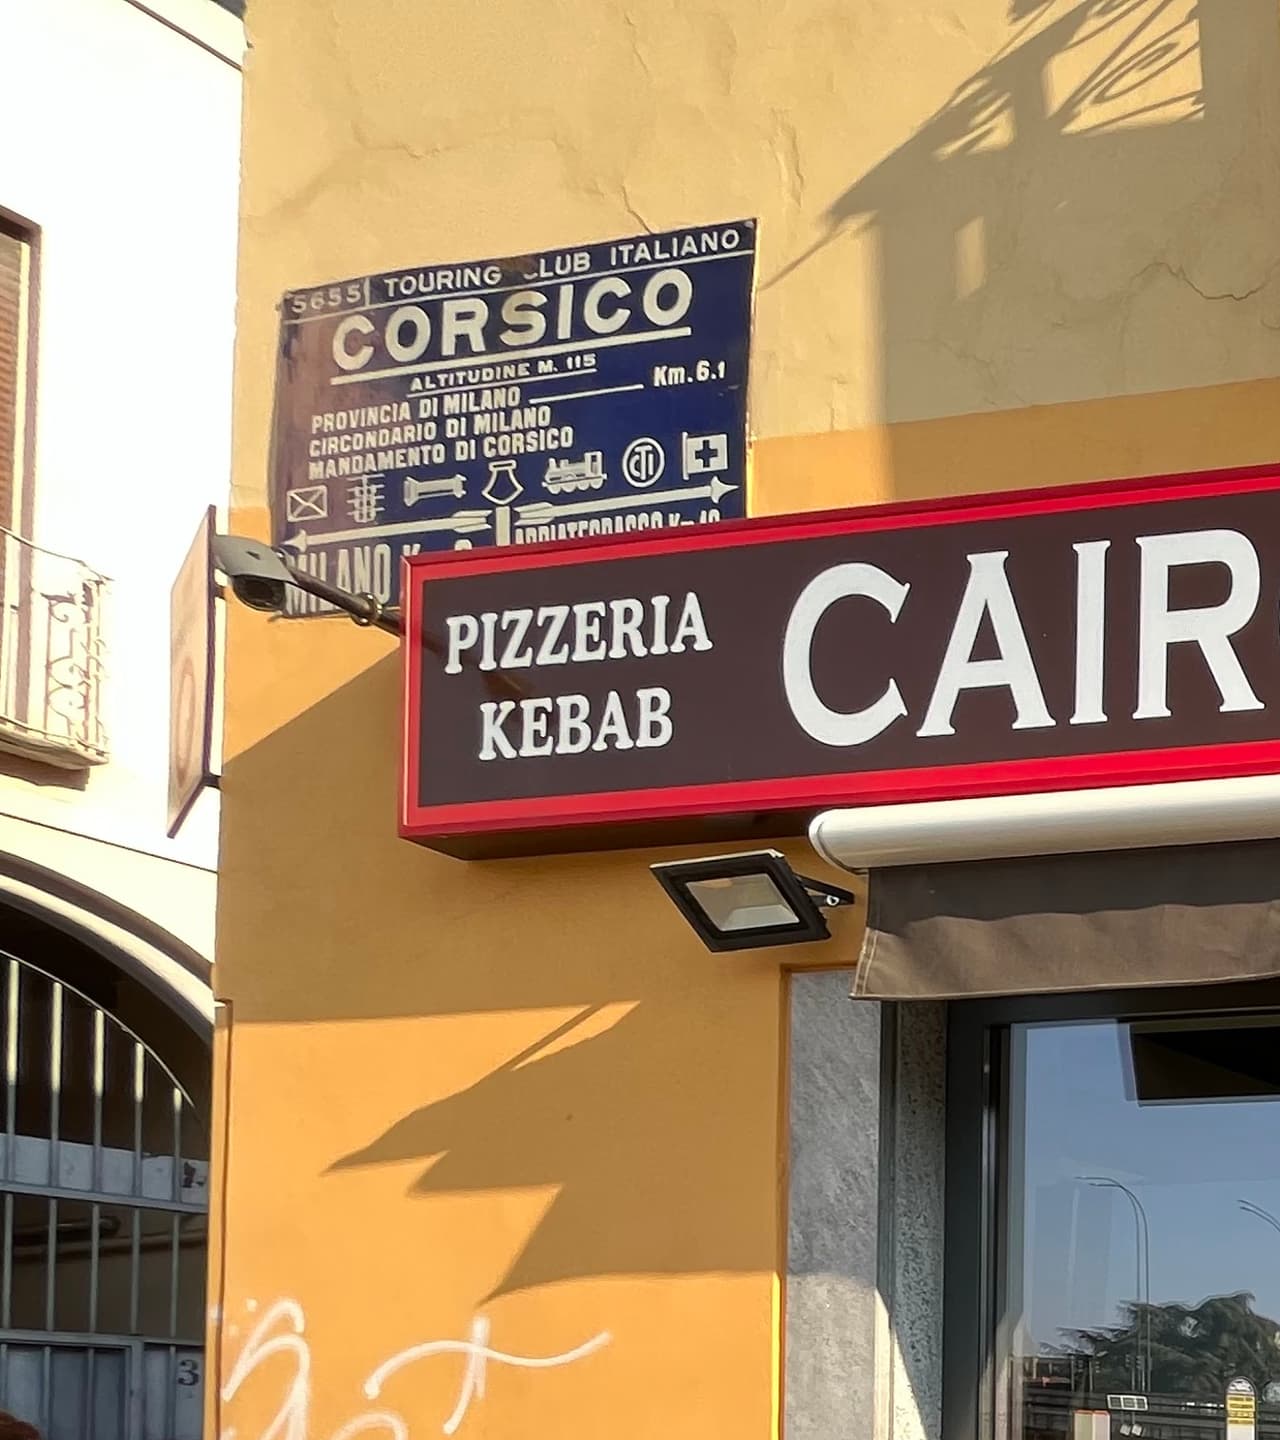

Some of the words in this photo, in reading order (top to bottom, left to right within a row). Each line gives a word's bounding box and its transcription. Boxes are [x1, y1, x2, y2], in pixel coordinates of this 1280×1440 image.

[384, 266, 501, 298] TOURING
[522, 252, 591, 280] LUB
[610, 229, 740, 266] ITALIANO
[331, 268, 693, 371] CORSICO
[410, 363, 530, 393] ALTITUDINE
[537, 360, 559, 374] M.
[566, 353, 597, 371] 115
[309, 422, 435, 458] CIRCONDARIO
[446, 418, 467, 438] DI
[473, 406, 551, 434] MILANO
[312, 403, 410, 434] PROVINCIA
[418, 398, 439, 418] DI
[443, 386, 522, 416] MILANO
[308, 446, 446, 480] MANDAMENTO
[455, 441, 476, 461] DI
[483, 428, 574, 459] CORSICO
[445, 592, 713, 676] PIZZERIA
[478, 687, 675, 762] KEBAB
[177, 1359, 199, 1387] 3
